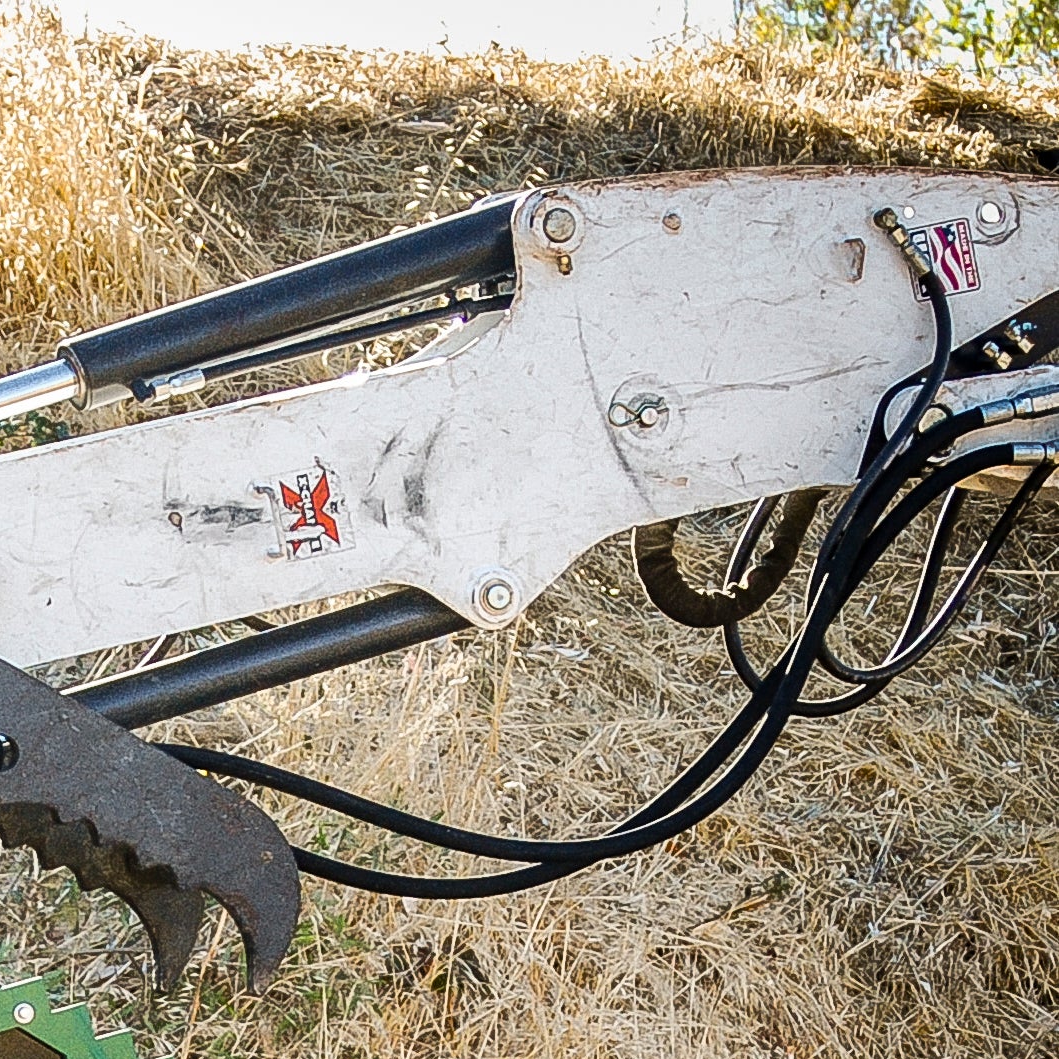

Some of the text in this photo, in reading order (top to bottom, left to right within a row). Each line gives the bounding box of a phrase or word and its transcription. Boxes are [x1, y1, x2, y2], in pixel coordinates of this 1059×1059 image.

[958, 224, 975, 285] MADE IN THE
[298, 476, 322, 550] X-CHAE
